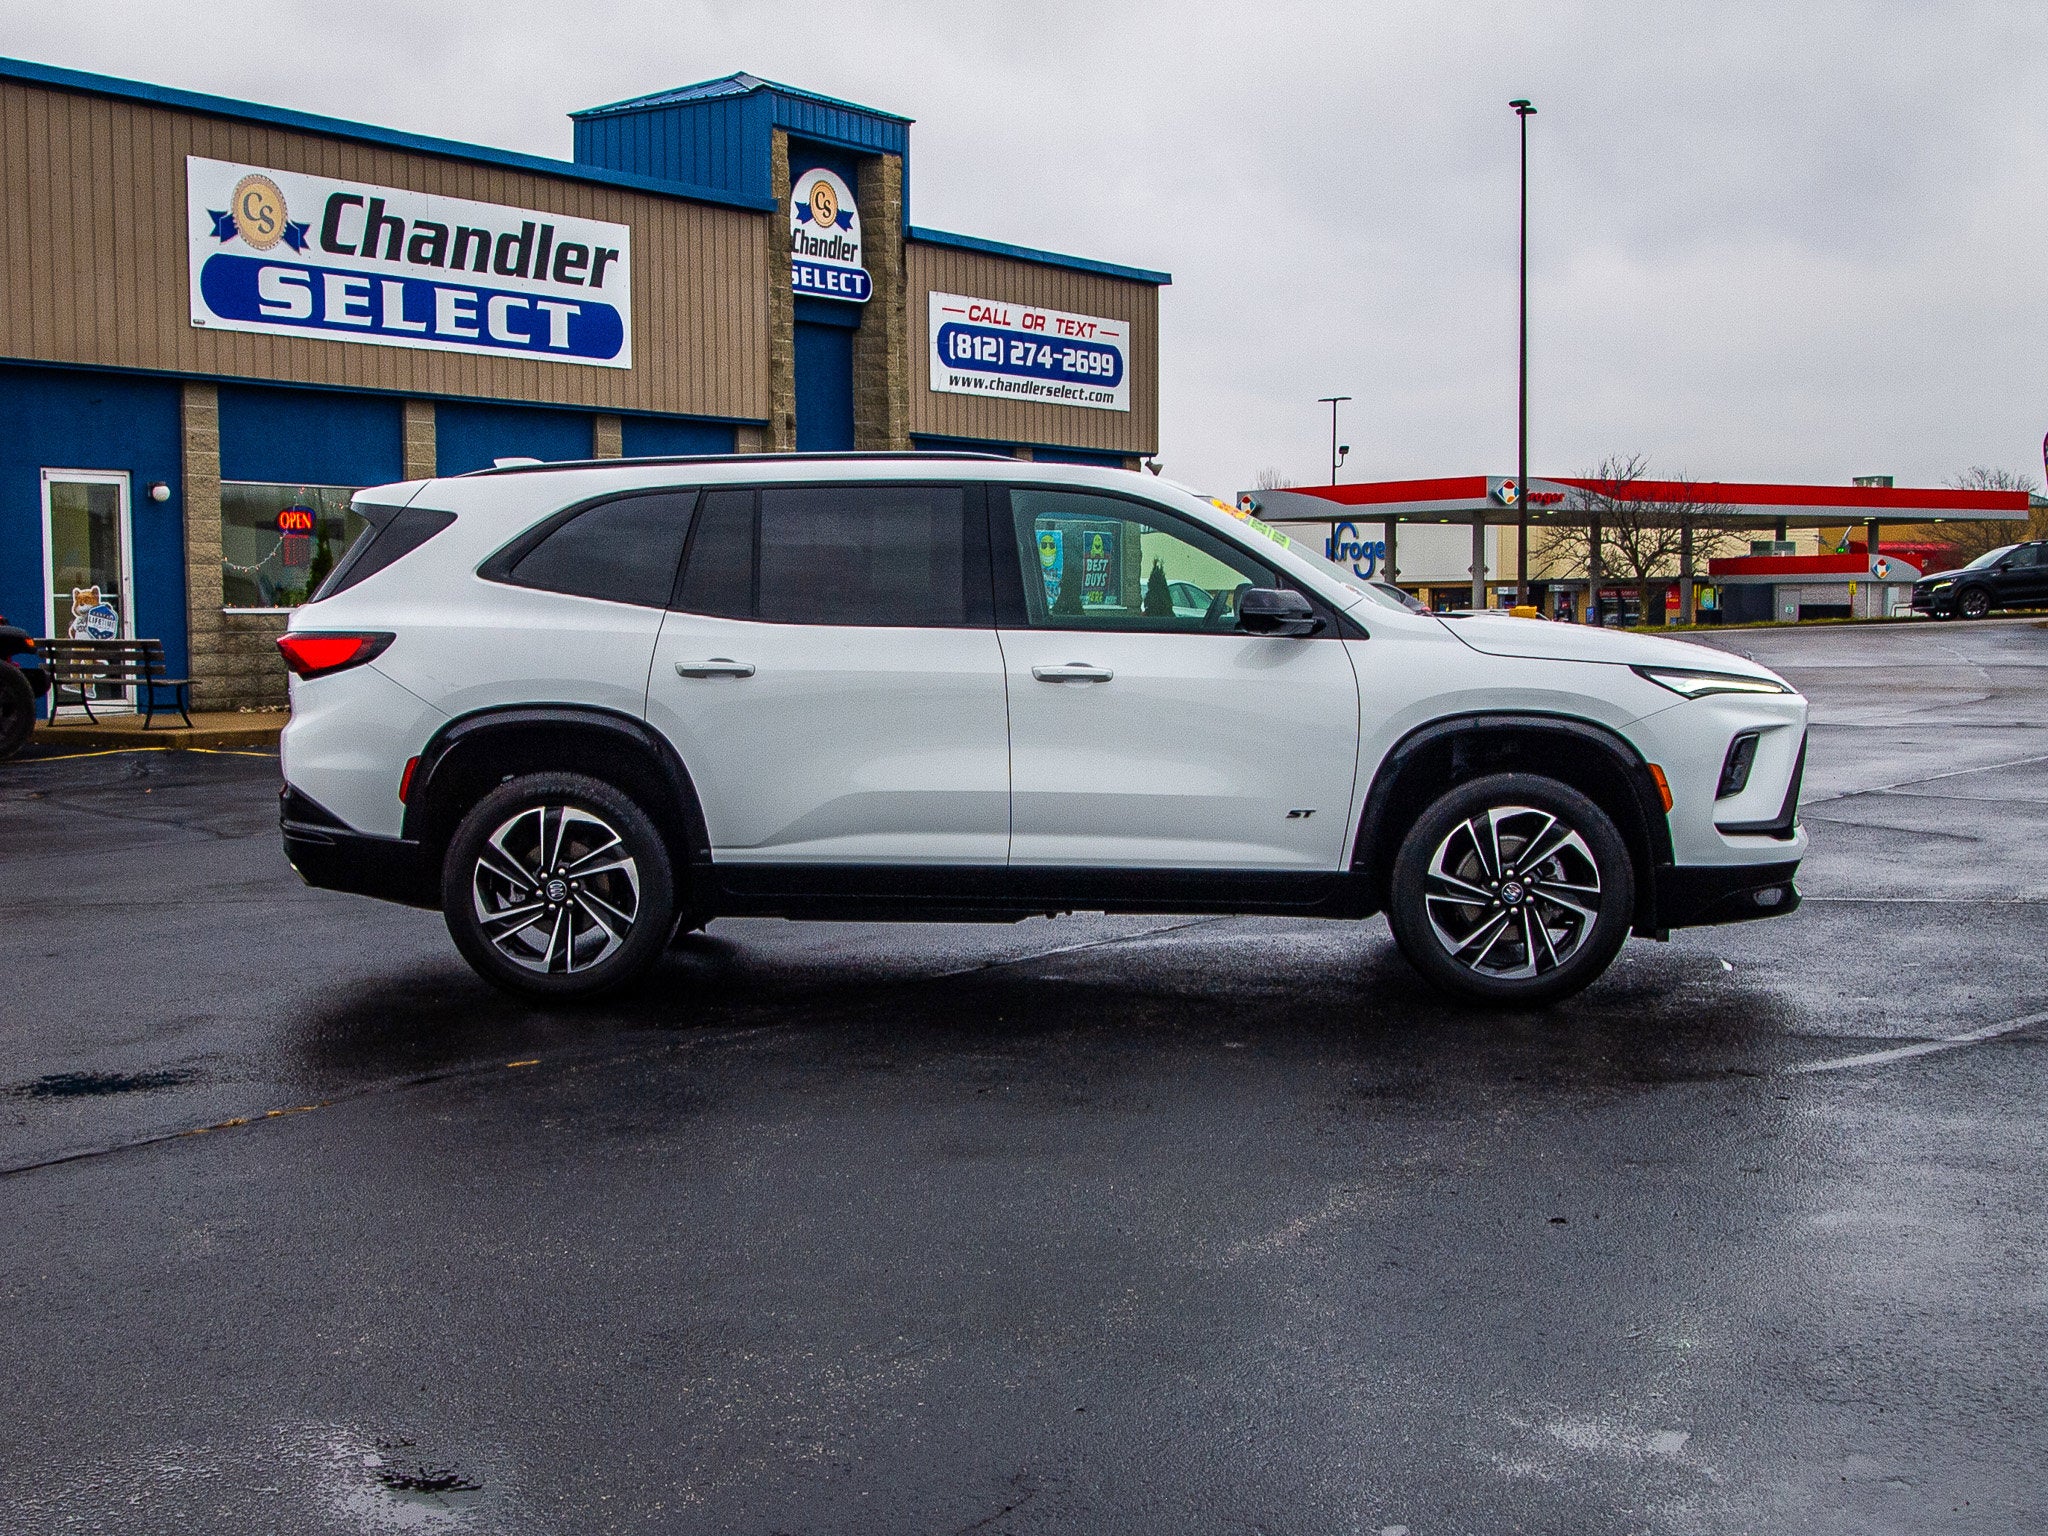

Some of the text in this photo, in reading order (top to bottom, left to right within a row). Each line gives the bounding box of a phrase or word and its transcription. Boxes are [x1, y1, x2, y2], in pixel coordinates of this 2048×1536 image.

[320, 191, 619, 288] Chandler
[792, 228, 858, 262] Chandler
[258, 266, 581, 349] SELECT
[968, 305, 1097, 338] CALL OR TEXT
[949, 331, 1114, 377] (812) 274-2699
[949, 375, 1114, 404] www.chandlerselect.com
[1527, 490, 1565, 506] roger
[279, 511, 313, 529] OPEN
[1086, 558, 1109, 571] BEST
[1325, 521, 1387, 580] Kroge
[1084, 573, 1108, 587] BUYS
[1286, 809, 1316, 818] ST
